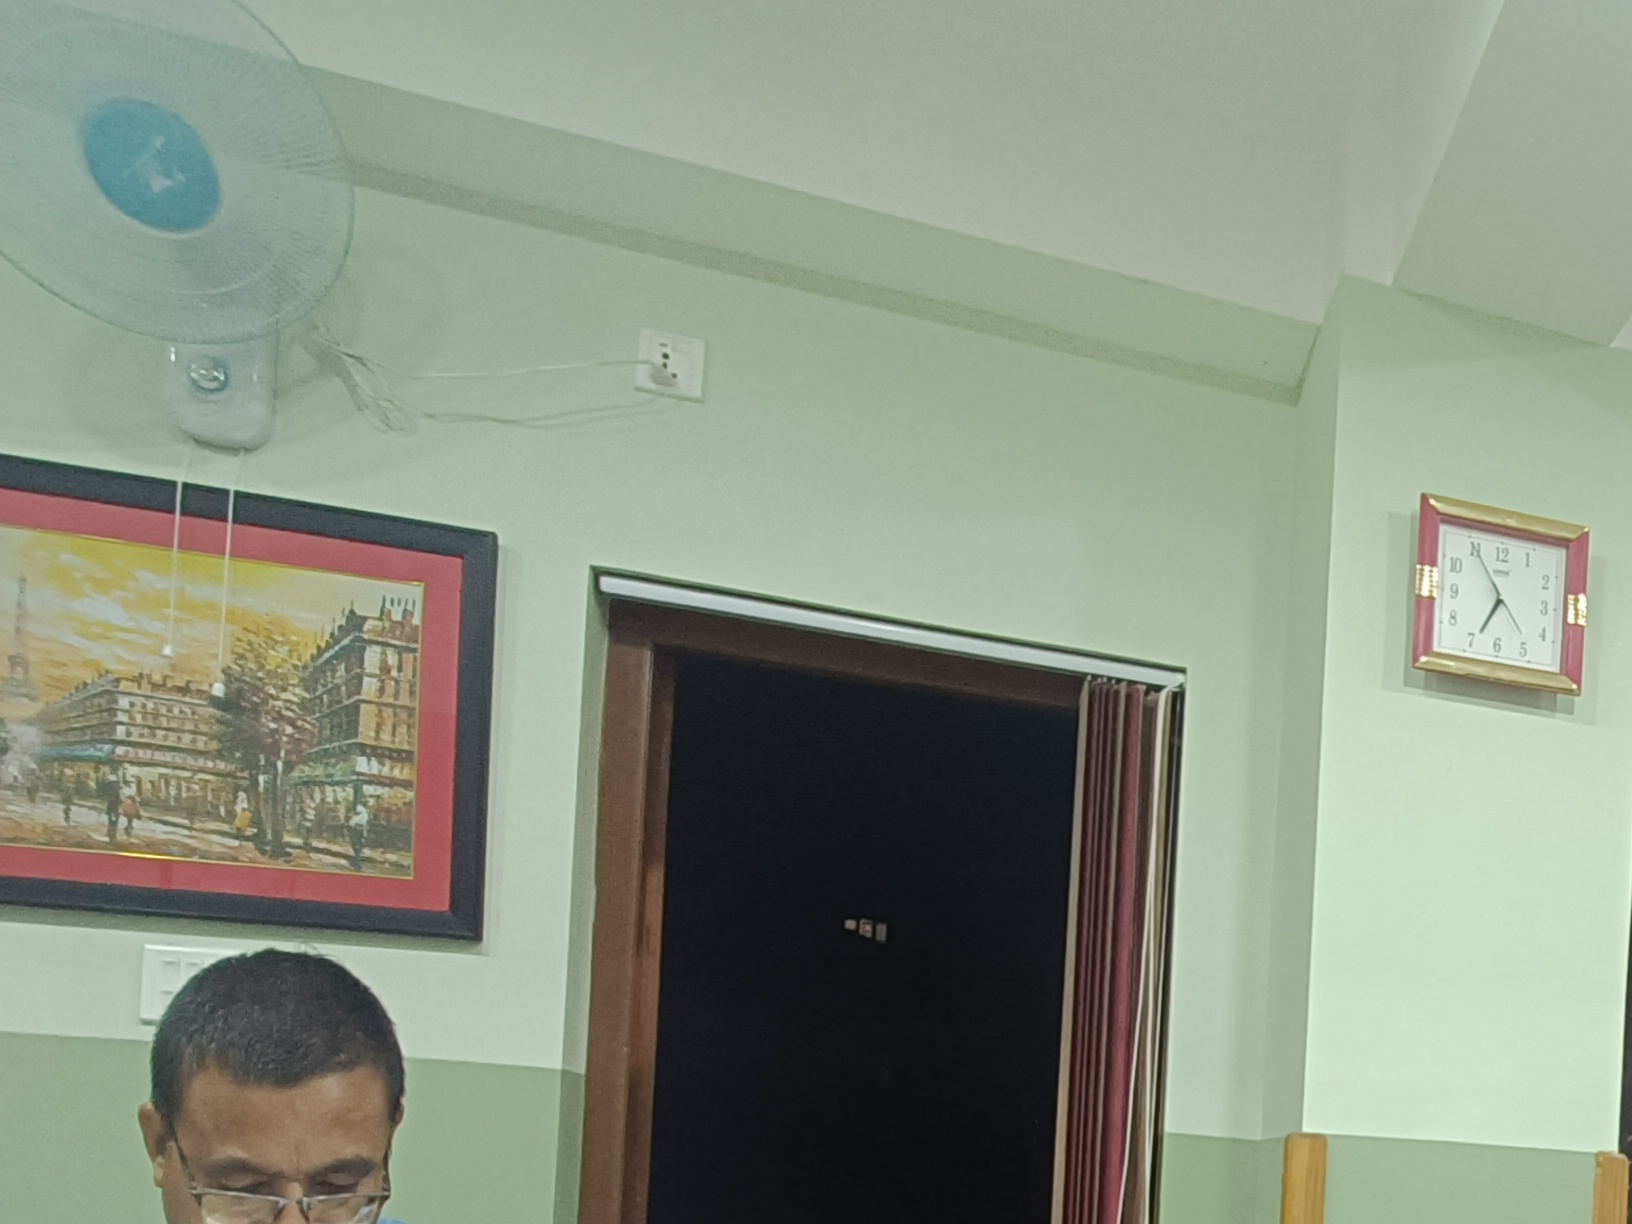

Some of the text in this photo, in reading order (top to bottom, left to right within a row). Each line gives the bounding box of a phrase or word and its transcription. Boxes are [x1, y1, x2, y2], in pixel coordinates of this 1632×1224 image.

[1494, 546, 1510, 564] 12
[1525, 552, 1531, 568] 1
[1449, 557, 1463, 574] 10
[1541, 574, 1550, 590] 2
[1449, 583, 1459, 599] 9
[1539, 600, 1548, 616] 3
[1448, 610, 1458, 626] 8
[1466, 632, 1476, 648] 7
[1538, 626, 1547, 642] 4
[1492, 637, 1502, 653] 6
[1518, 641, 1528, 658] 5
